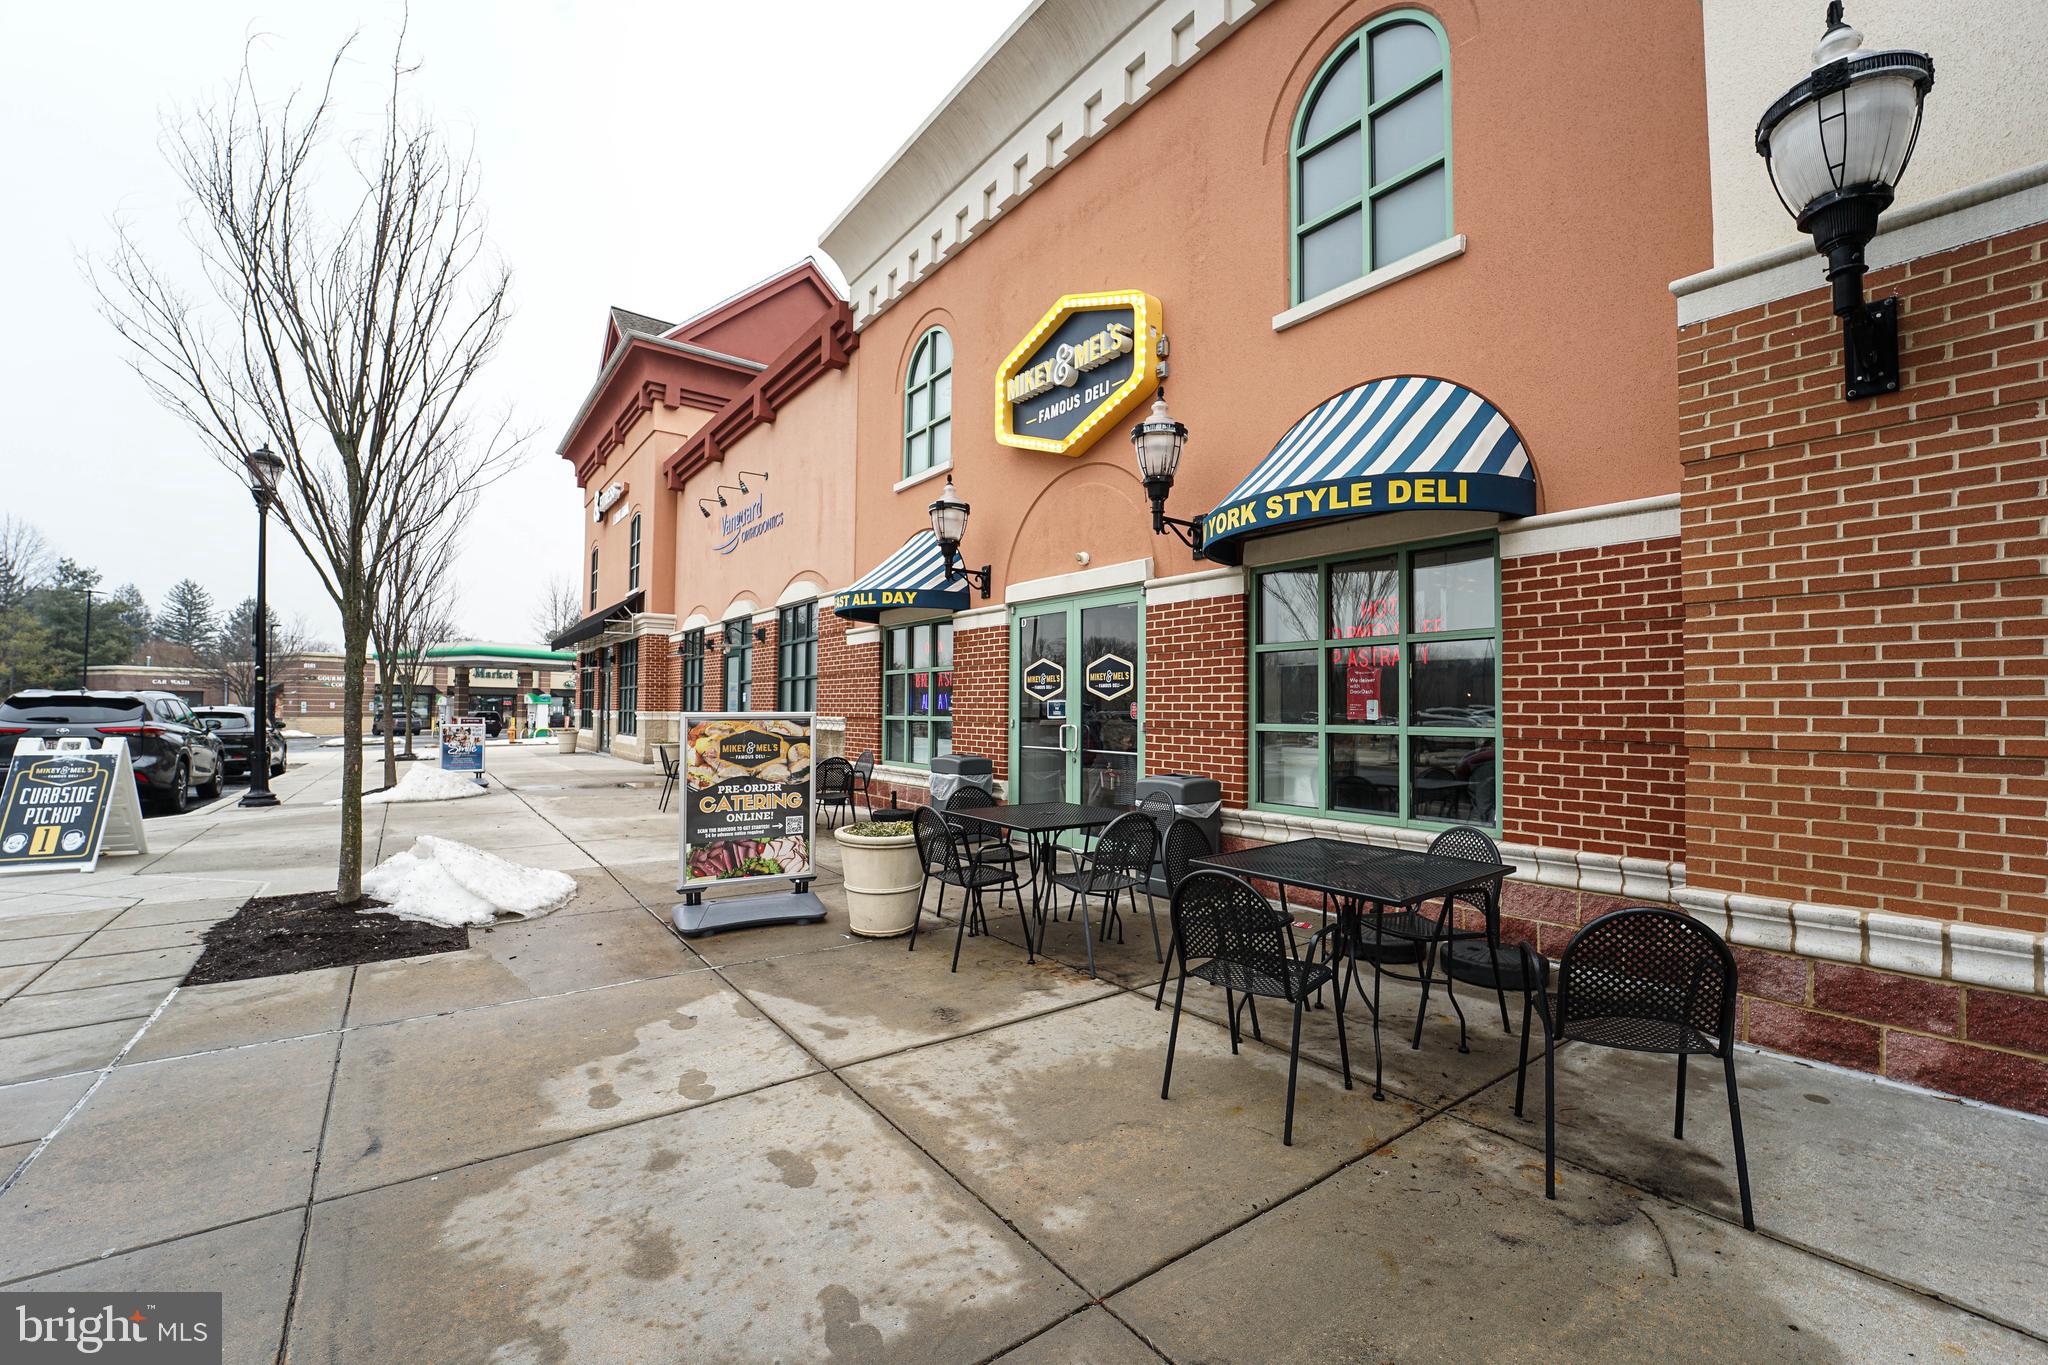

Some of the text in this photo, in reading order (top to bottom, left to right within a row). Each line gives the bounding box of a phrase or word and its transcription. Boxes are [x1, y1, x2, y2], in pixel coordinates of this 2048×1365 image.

[1007, 323, 1133, 403] MIKEY & MEL'S
[1038, 380, 1109, 423] FAMOUS DELI
[722, 493, 763, 537] Vanguard
[1208, 501, 1257, 538] YORK
[1265, 482, 1372, 519] STYLE
[1388, 479, 1467, 504] DELI
[741, 512, 784, 543] ORTHODONTICS
[852, 592, 877, 606] ALL
[881, 591, 917, 604] DAY
[1333, 644, 1427, 667] PASTRAI
[474, 668, 513, 679] Market
[1027, 673, 1060, 684] MIKEY & MEL'S
[1090, 669, 1130, 683] MIKEY & MEL'S
[722, 741, 779, 754] MIKEY & MEL'S
[60, 766, 68, 774] &
[19, 786, 97, 804] CURBSIDE
[717, 783, 782, 794] PRE-ORDER
[699, 792, 803, 813] CATERING
[23, 806, 82, 825] PICKUP
[726, 812, 774, 822] ONLINE!
[38, 828, 51, 852] 1
